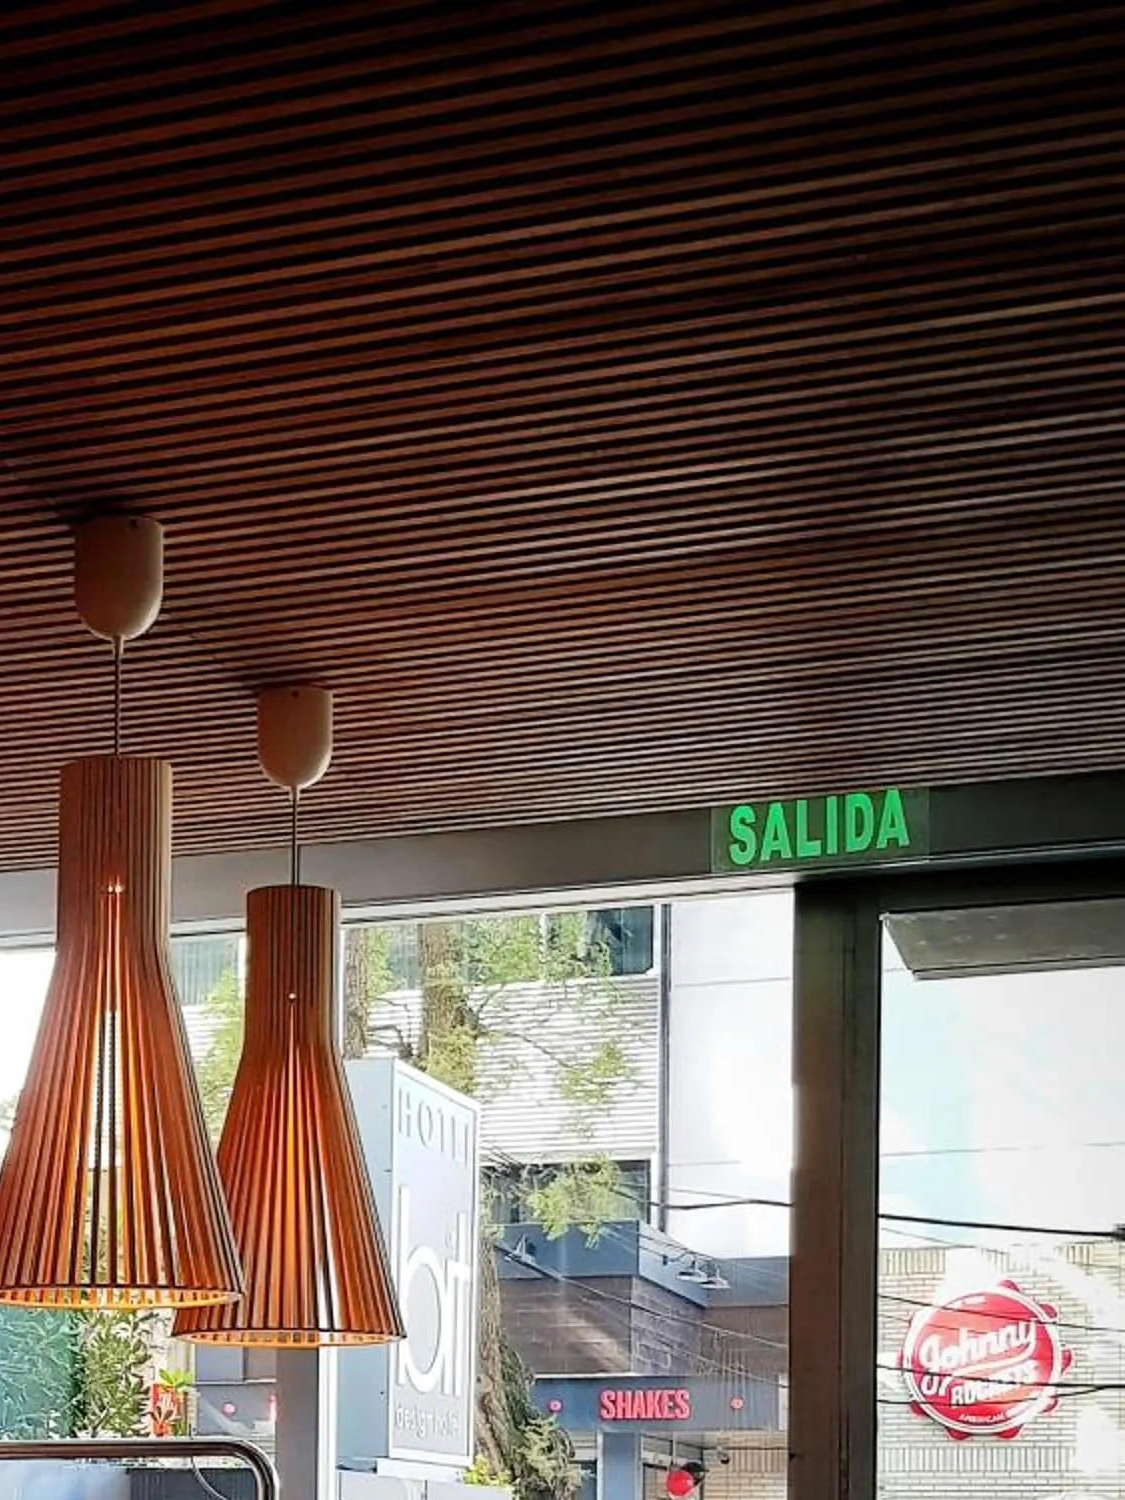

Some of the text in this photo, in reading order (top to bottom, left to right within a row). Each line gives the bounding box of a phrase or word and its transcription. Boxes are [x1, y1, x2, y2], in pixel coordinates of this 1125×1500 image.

[729, 787, 911, 865] SALIDA
[918, 1319, 1036, 1396] Johnny
[600, 1389, 691, 1420] SHAKES
